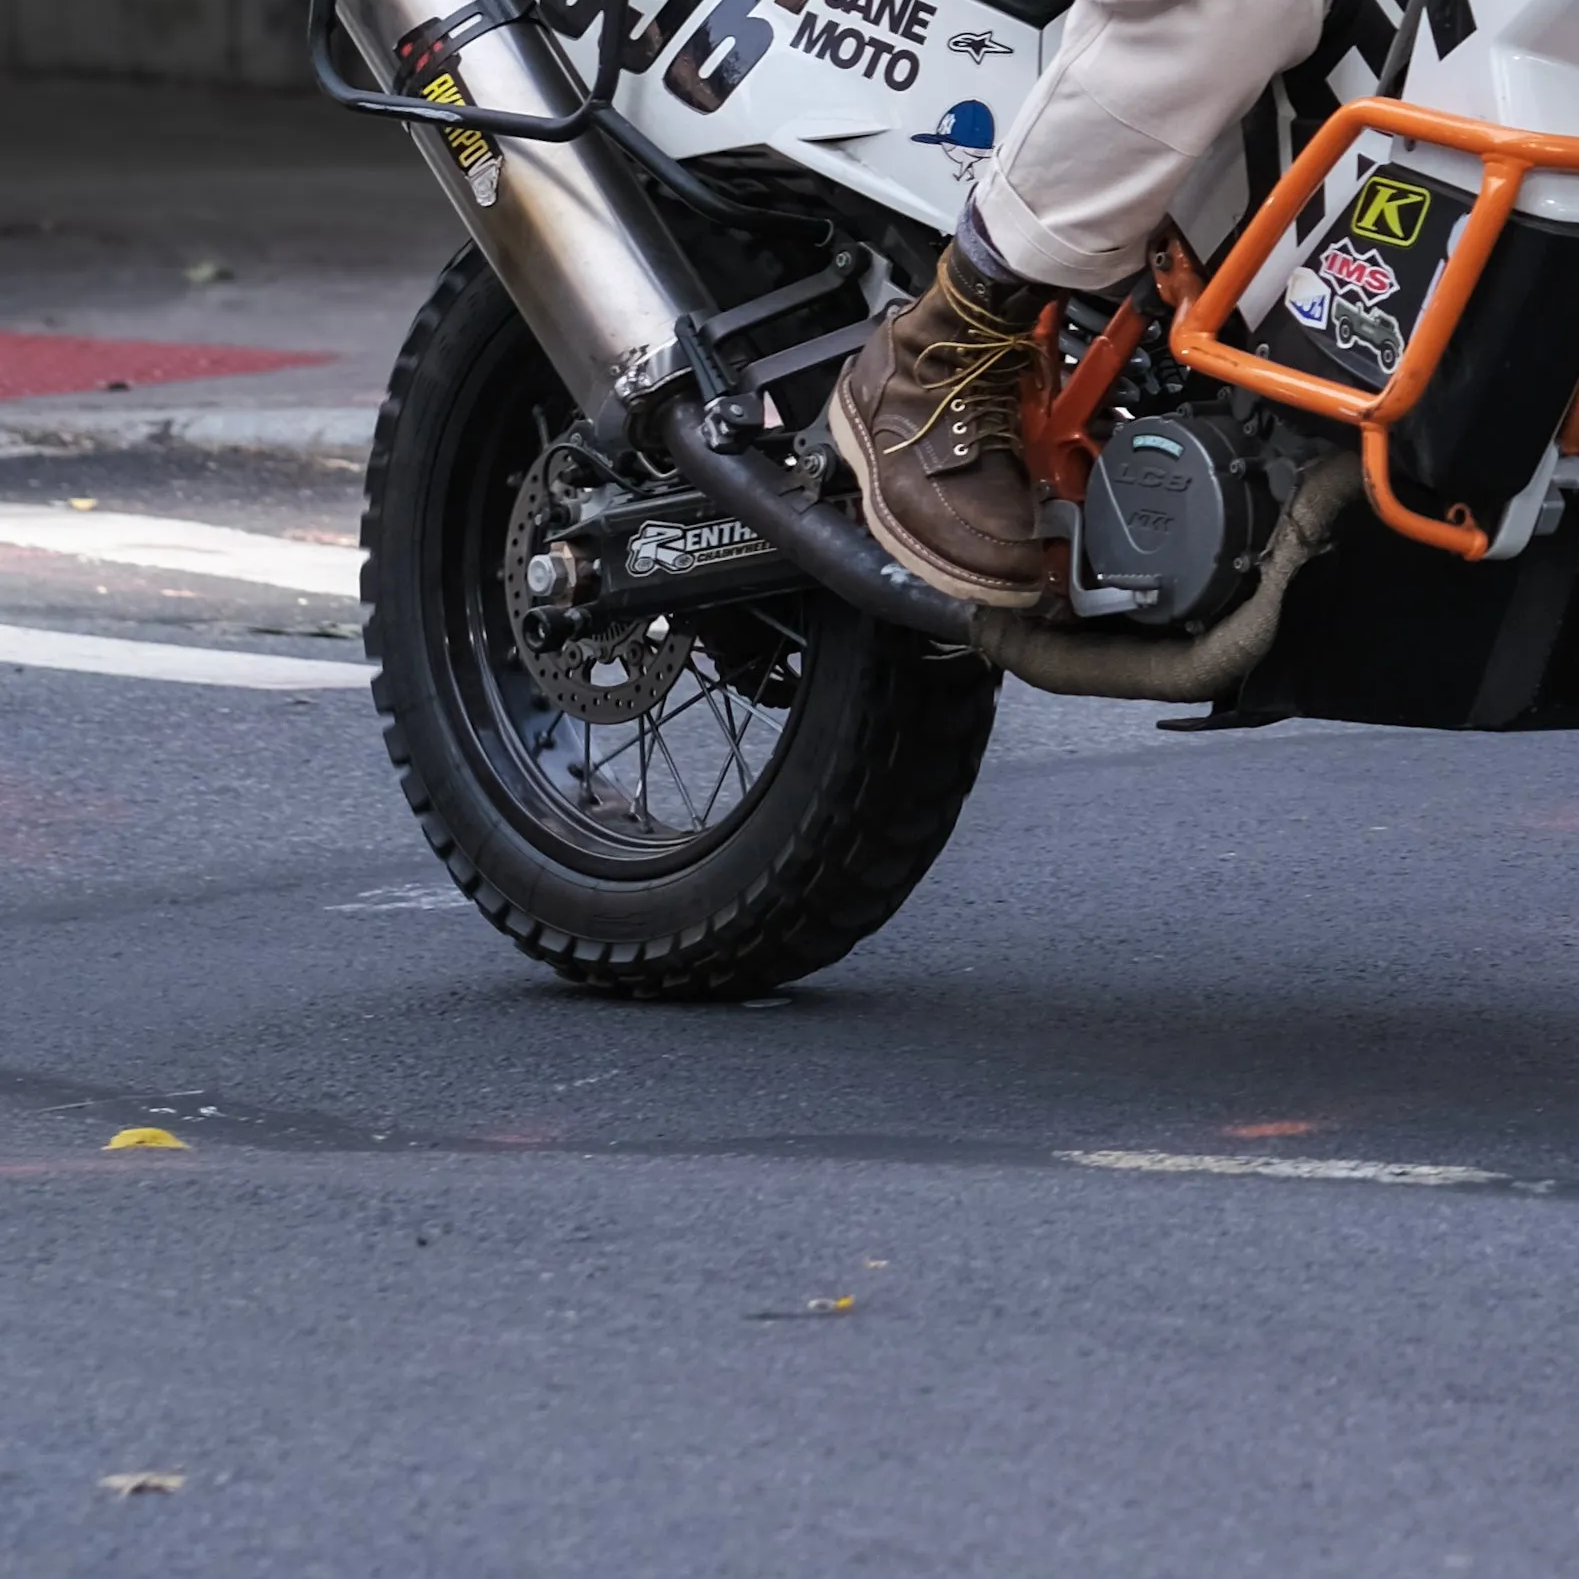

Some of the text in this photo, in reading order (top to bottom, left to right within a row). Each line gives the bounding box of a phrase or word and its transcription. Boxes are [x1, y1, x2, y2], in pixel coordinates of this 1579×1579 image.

[789, 10, 921, 93] MOTO
[1356, 185, 1425, 239] K
[1326, 251, 1391, 294] IMS
